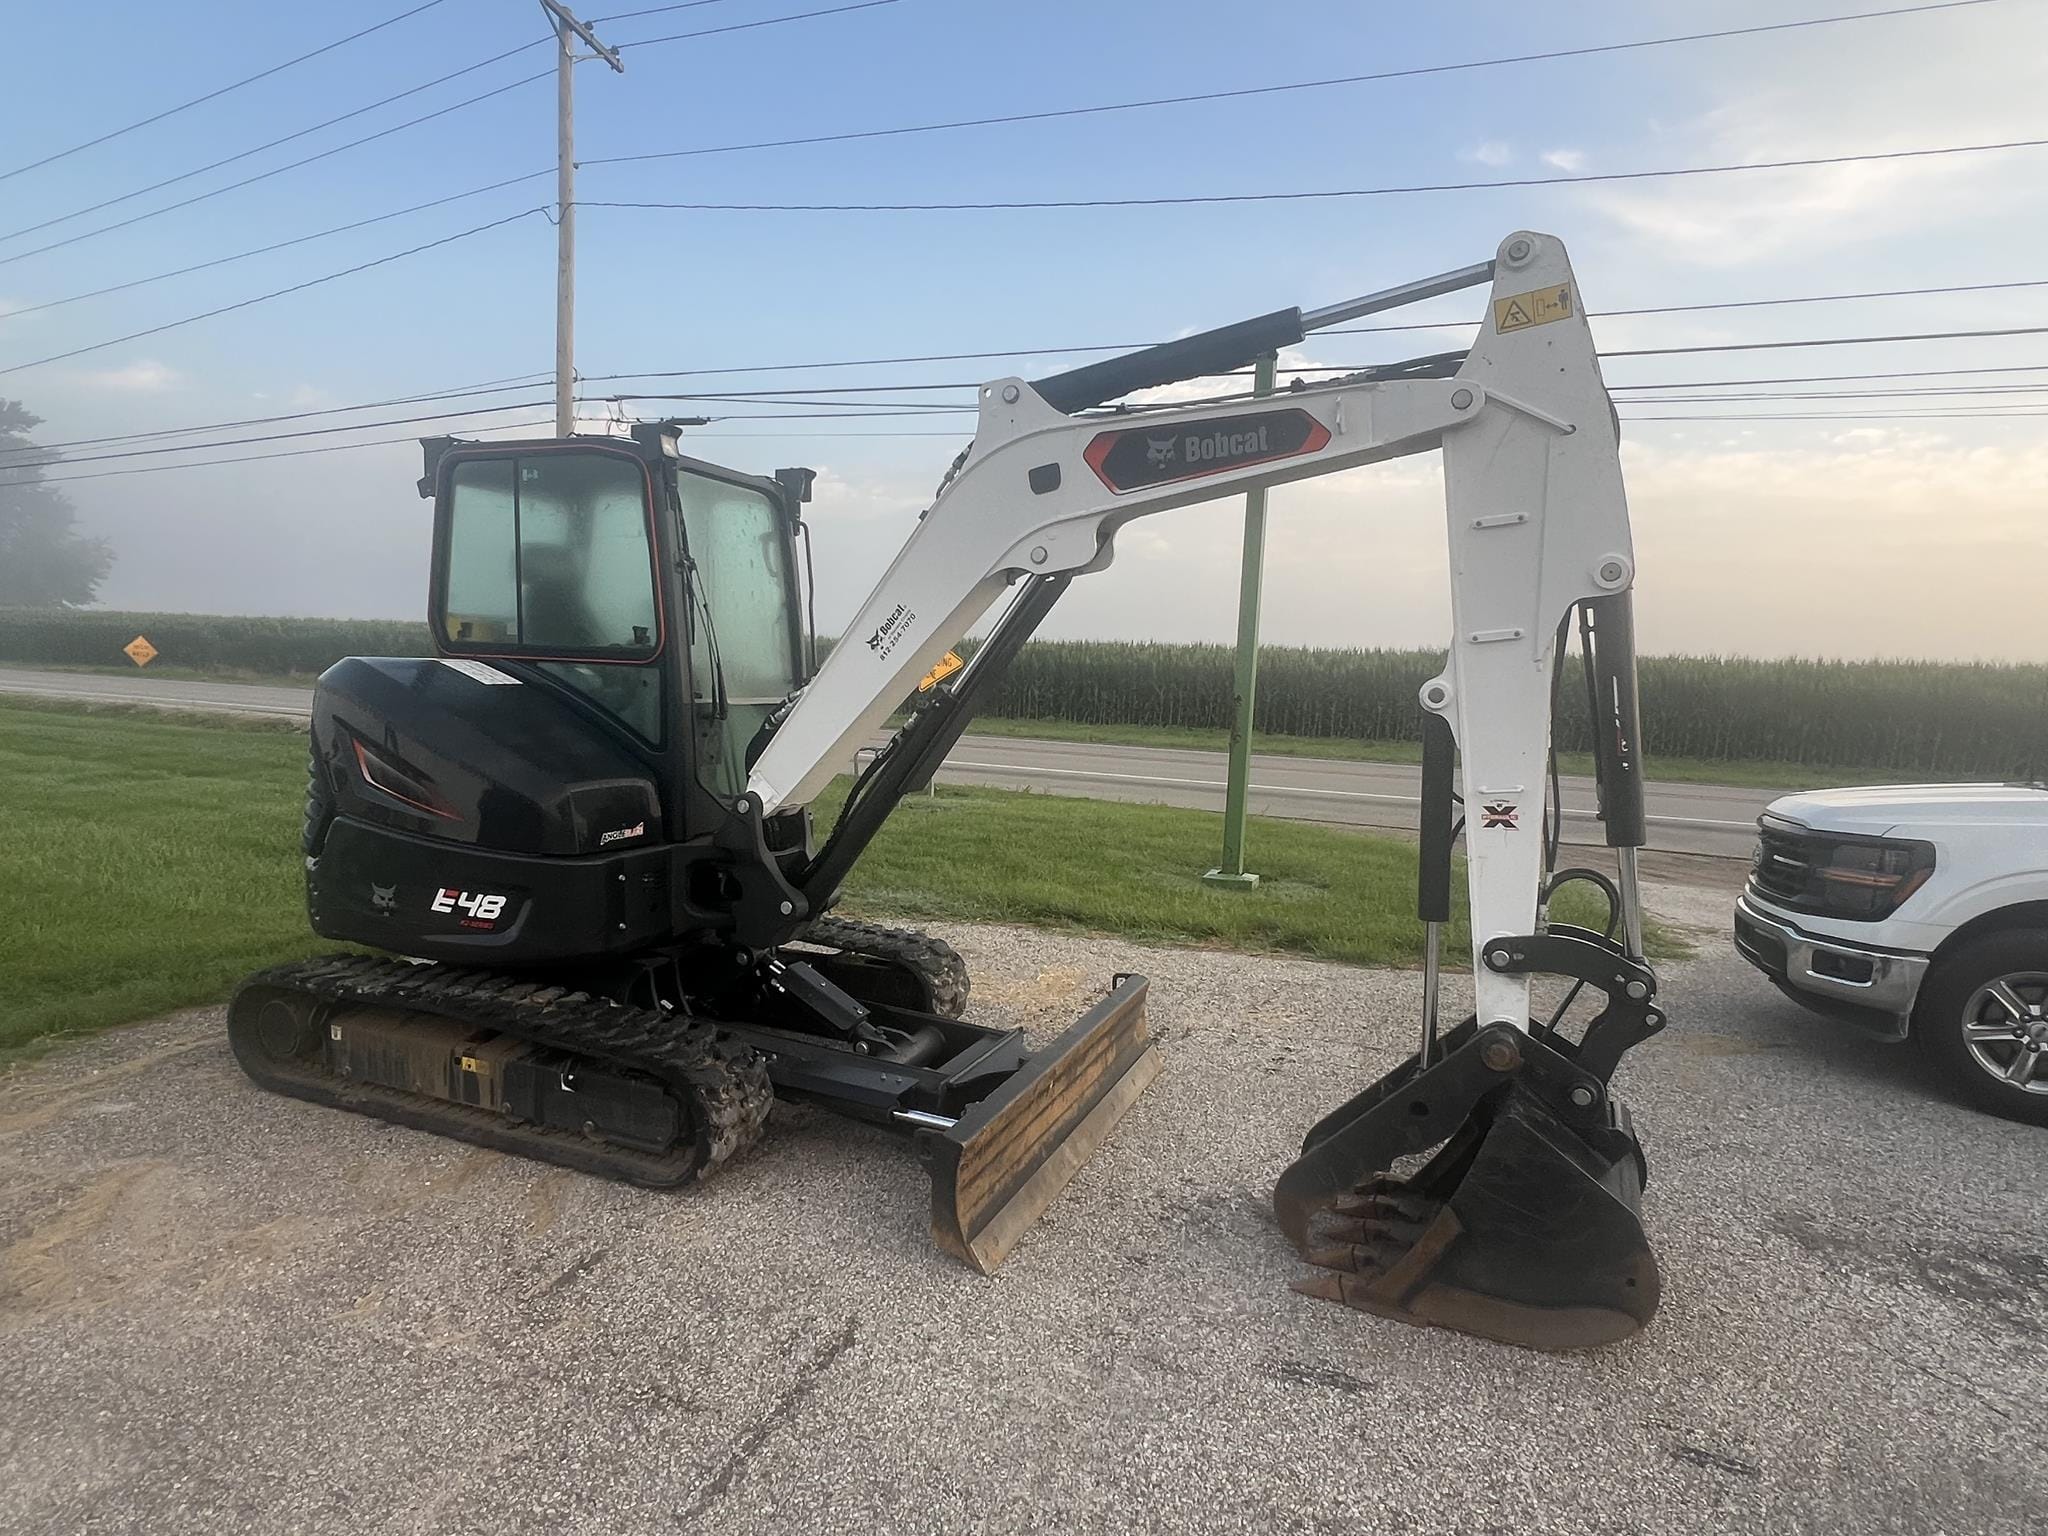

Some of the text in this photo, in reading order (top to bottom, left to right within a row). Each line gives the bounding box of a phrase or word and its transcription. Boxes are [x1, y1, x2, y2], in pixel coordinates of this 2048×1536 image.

[1185, 427, 1268, 462] Bobcat
[879, 604, 905, 636] Bobcat
[431, 888, 507, 920] E48
